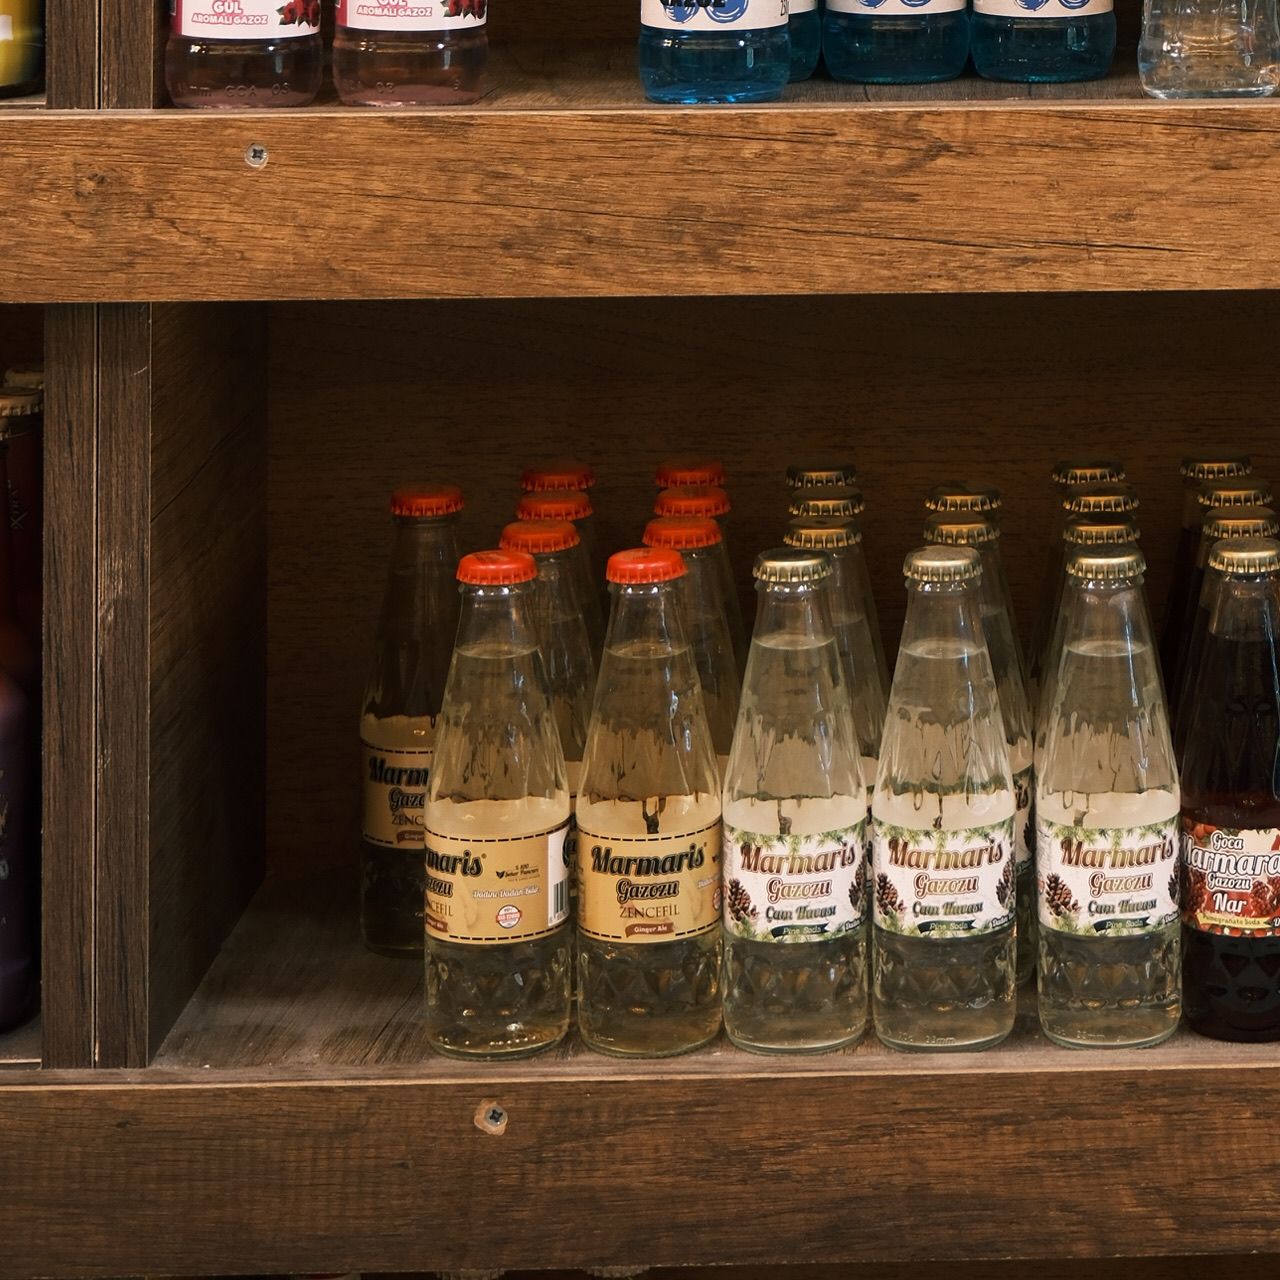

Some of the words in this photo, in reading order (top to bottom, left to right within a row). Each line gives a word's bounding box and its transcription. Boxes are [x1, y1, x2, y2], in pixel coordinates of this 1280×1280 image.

[357, 6, 398, 17] AROMALI
[398, 6, 432, 17] GAZOZ
[1060, 835, 1174, 869] Marmaris
[1211, 830, 1244, 851] Goca
[592, 842, 705, 877] Marmaris
[888, 836, 1003, 872] Marmaris
[616, 879, 680, 904] Gazozu
[913, 873, 980, 900] Gazozu
[1088, 872, 1153, 898] Gazozu
[1206, 873, 1252, 892] Gazozu
[619, 905, 680, 919] ZENCEFİL
[1212, 892, 1247, 914] Nar
[634, 926, 656, 935] Ginger
[657, 925, 668, 933] Ale
